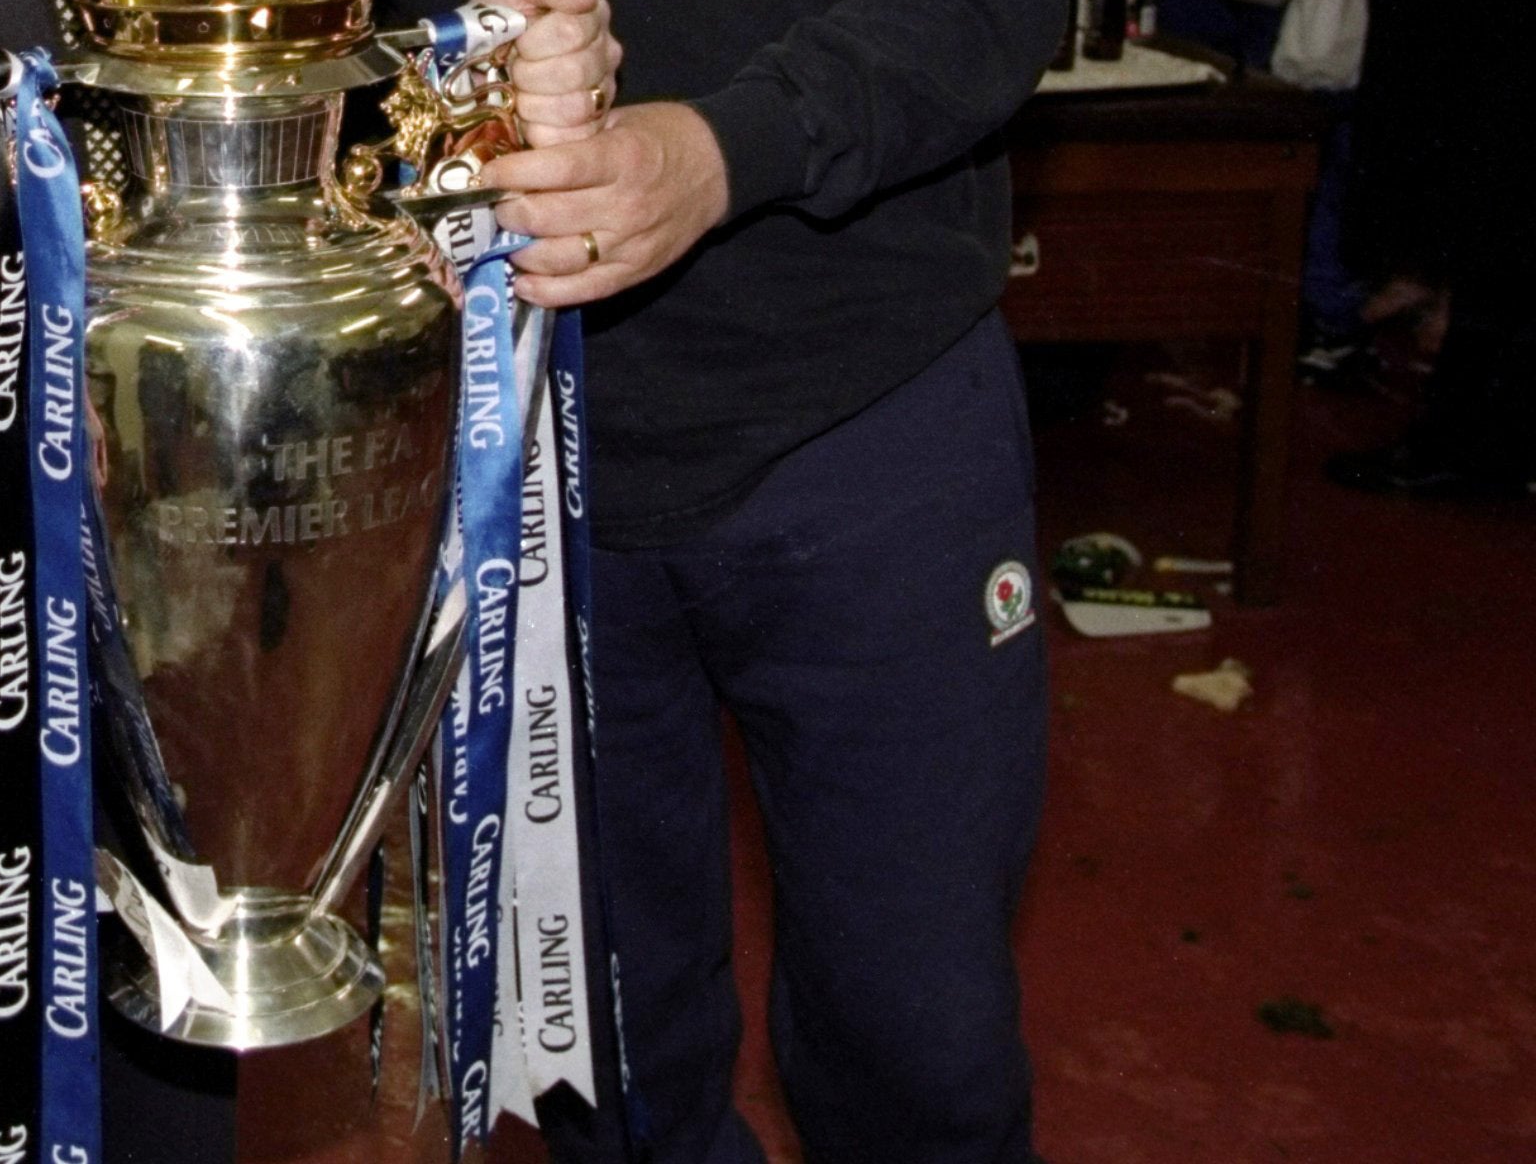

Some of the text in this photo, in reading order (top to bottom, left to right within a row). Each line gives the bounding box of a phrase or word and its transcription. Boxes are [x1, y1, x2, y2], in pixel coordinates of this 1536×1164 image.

[39, 303, 73, 481] CARLING
[464, 286, 504, 450] CARLING
[557, 369, 584, 520] CARLING
[158, 499, 350, 547] PREMIER
[267, 435, 353, 482] THE
[40, 595, 80, 767] CARLING
[476, 557, 515, 716] CARLING
[525, 684, 561, 825] CARLING
[45, 877, 89, 1040] CARLING
[466, 812, 501, 970] CARLING
[538, 912, 577, 1055] CARLING
